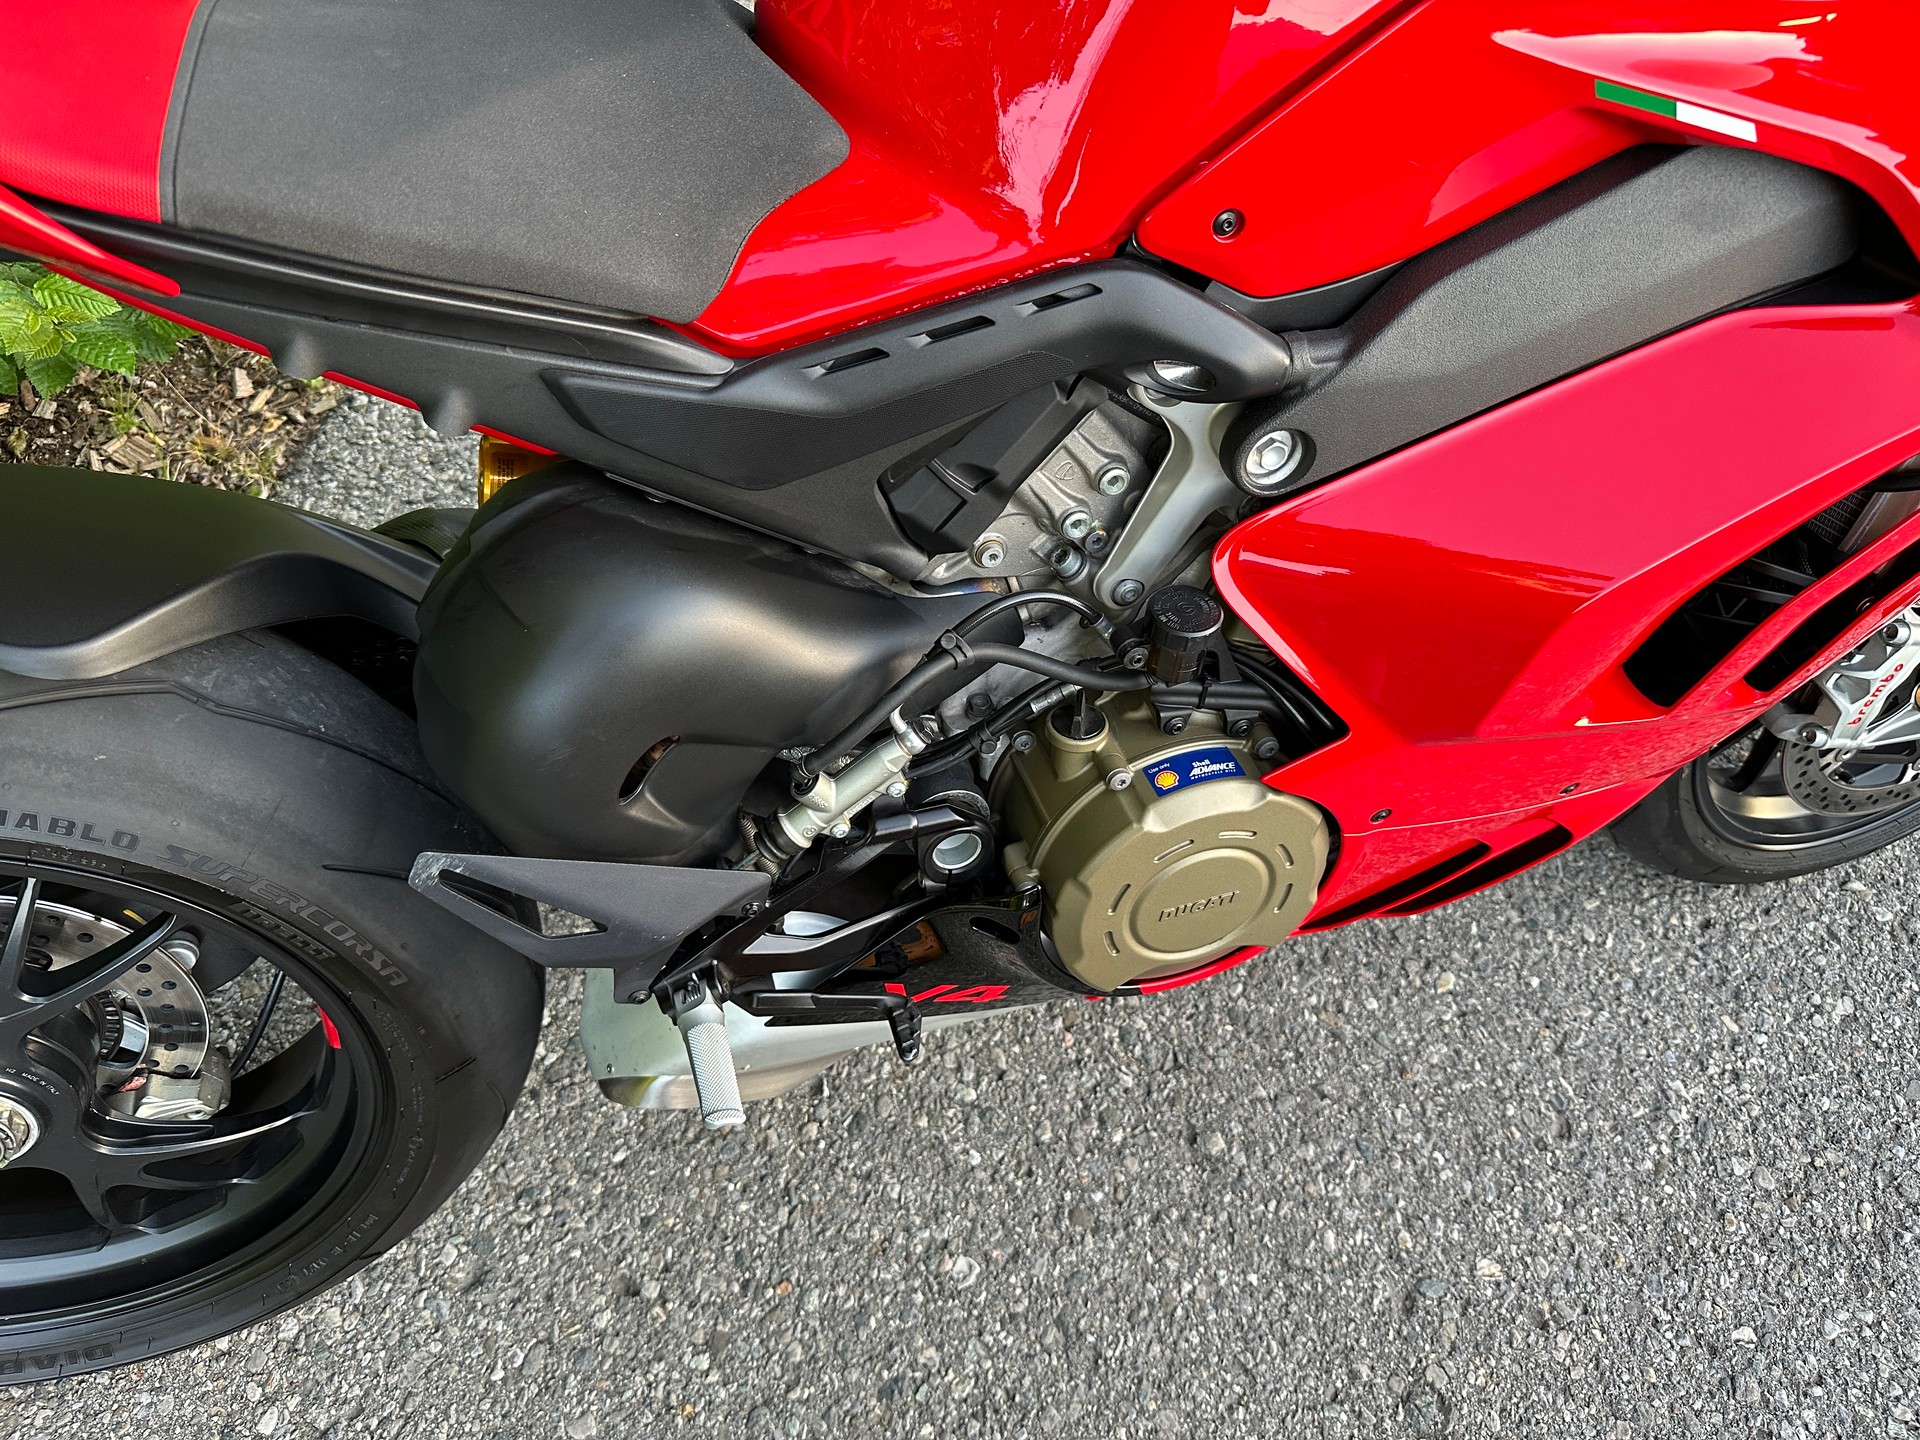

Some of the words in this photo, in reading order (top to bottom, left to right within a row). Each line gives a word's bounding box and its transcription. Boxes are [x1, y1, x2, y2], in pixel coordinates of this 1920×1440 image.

[1846, 662, 1904, 726] brembo
[1148, 766, 1159, 774] Use
[1188, 761, 1236, 777] ADVANCE
[1192, 759, 1211, 768] Shell
[156, 844, 409, 986] SUPERCORSA
[1158, 890, 1240, 922] DUCATI
[884, 983, 1011, 1003] V4
